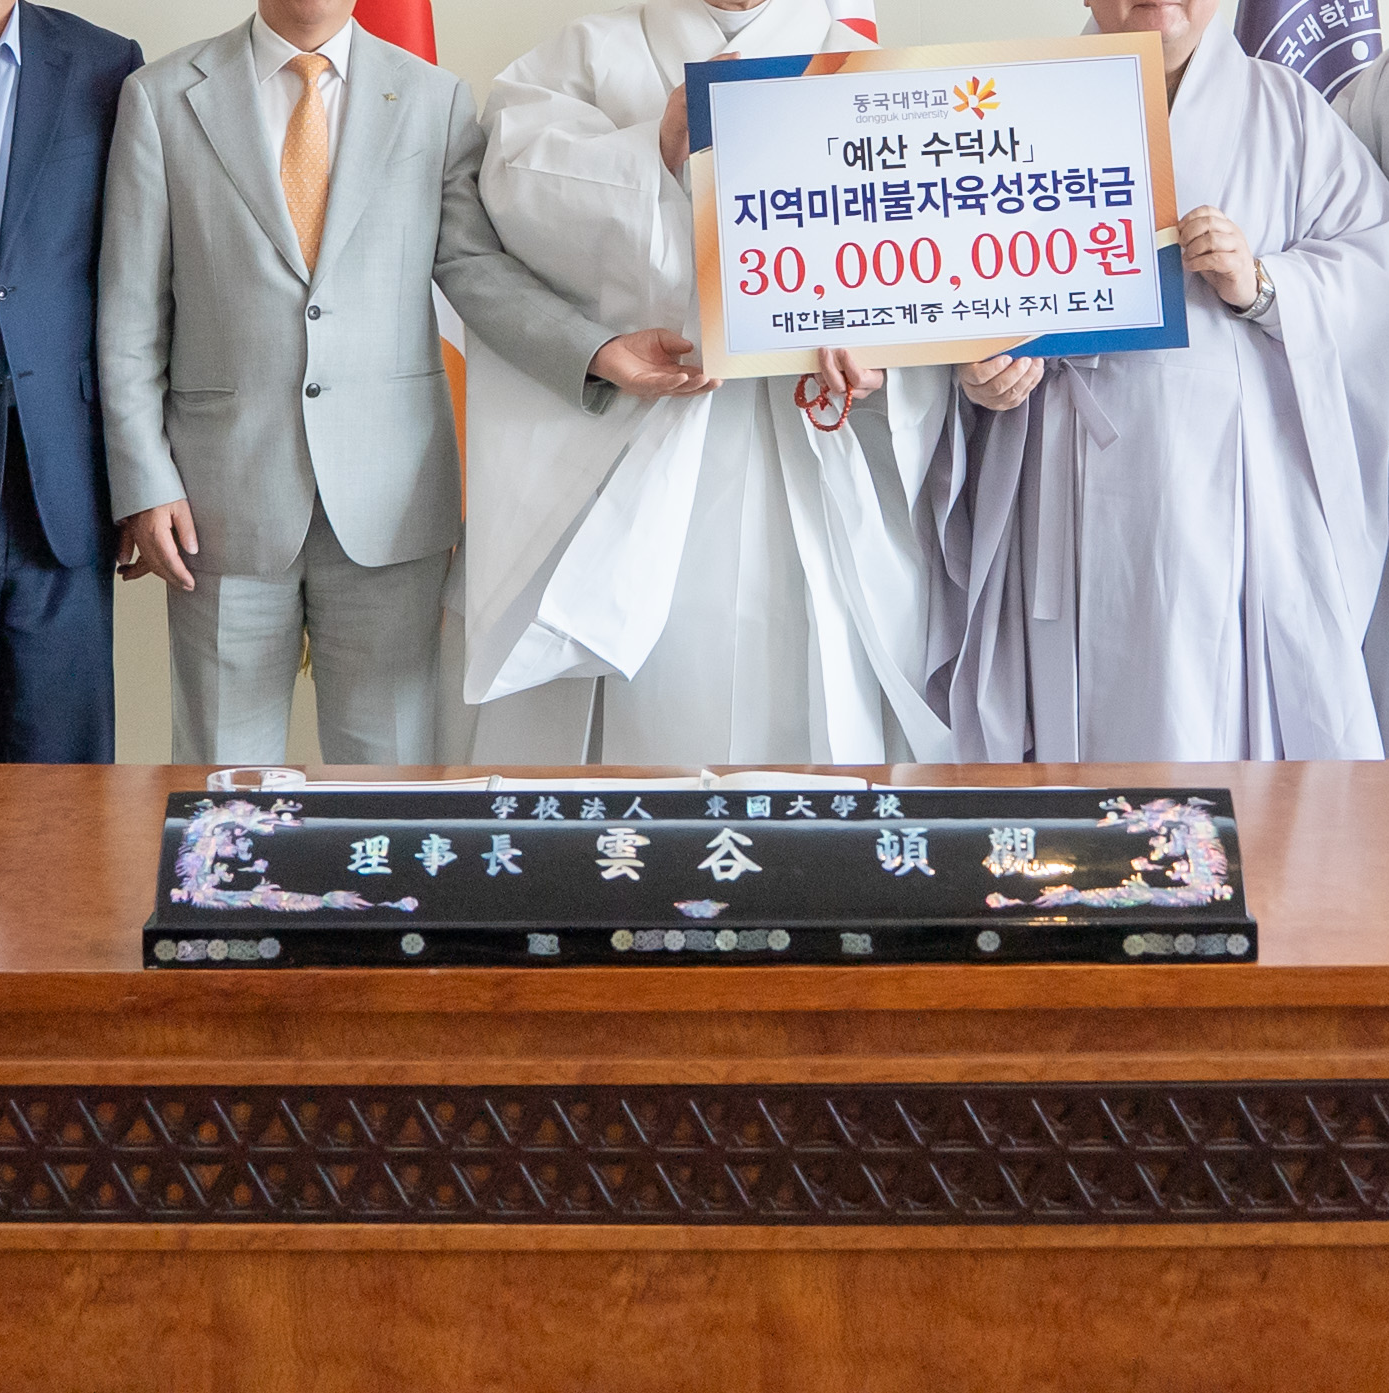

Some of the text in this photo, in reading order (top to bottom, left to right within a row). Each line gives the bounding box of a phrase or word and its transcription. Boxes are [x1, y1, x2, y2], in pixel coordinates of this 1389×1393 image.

[853, 89, 949, 114] 동국대학교
[856, 109, 949, 124] dongguk university
[826, 126, 1035, 172] 「예산 수덕사」
[734, 165, 1135, 231] 지역미래불자육성장학금
[739, 218, 1141, 301] 30,000,000원
[772, 288, 1114, 333] 대한불교조계종 수덕사 주지 도신
[491, 793, 905, 820] 學校法人 東國大學校
[347, 834, 523, 877] 理事長
[595, 827, 763, 882] 雲谷
